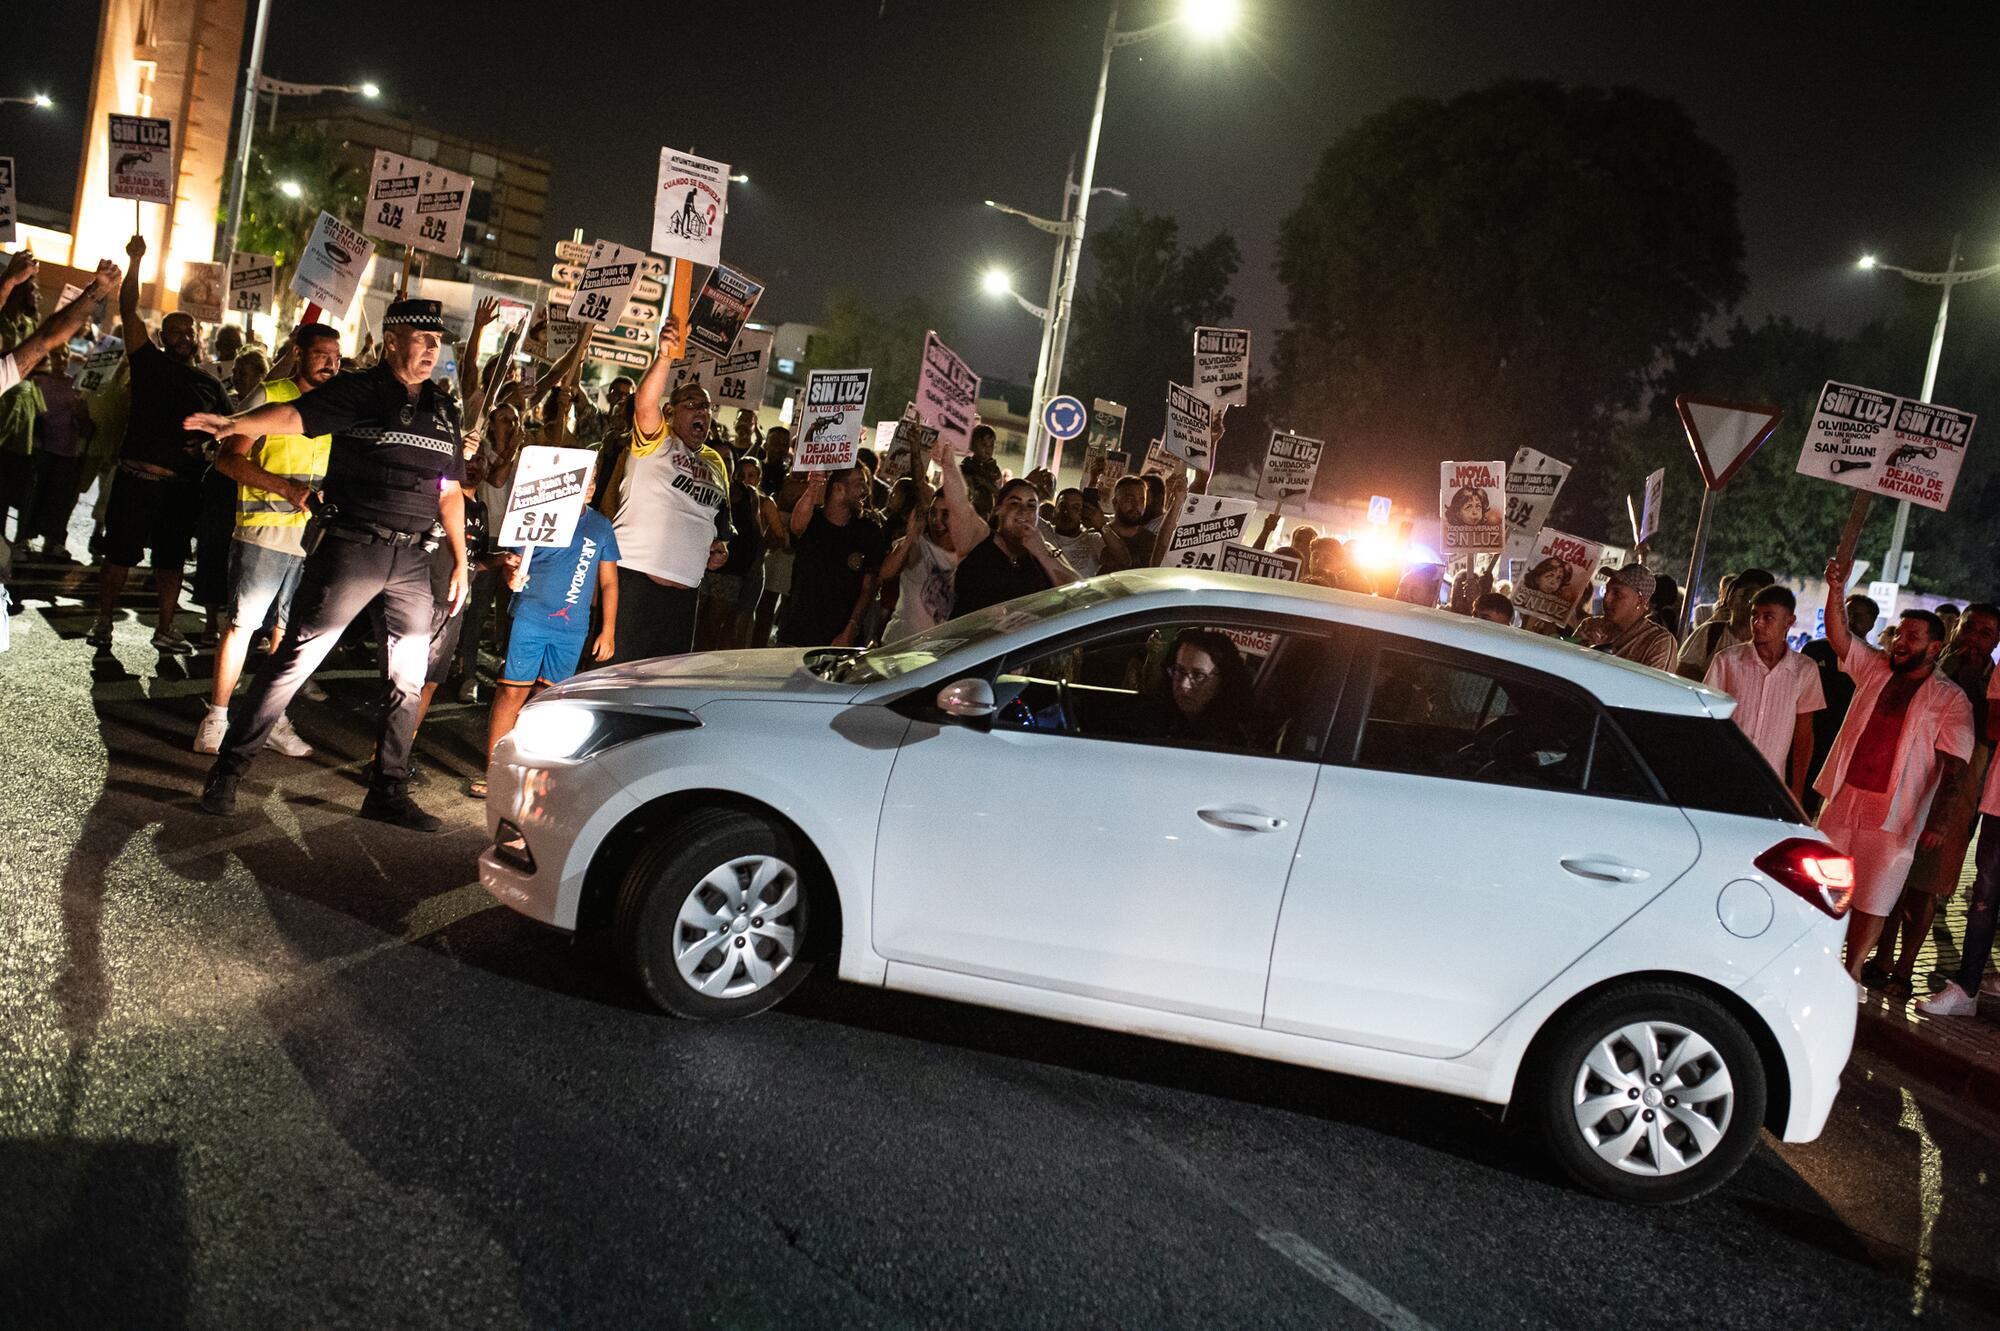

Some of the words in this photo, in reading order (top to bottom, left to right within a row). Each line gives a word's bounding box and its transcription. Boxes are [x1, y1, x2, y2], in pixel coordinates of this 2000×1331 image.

[112, 124, 137, 142] SIN
[140, 126, 168, 145] LUZ
[671, 155, 719, 174] AYUNTAMIENTO
[119, 176, 150, 186] DEJAD
[152, 178, 165, 188] DE
[664, 178, 688, 190] CUANDO
[690, 178, 697, 186] SE
[698, 181, 721, 205] EMPIEZA
[377, 212, 403, 229] LUZ
[706, 203, 717, 236] ?
[324, 216, 355, 239] ¡BASTA
[356, 235, 368, 249] DE
[419, 226, 447, 243] LUZ
[323, 226, 365, 256] SILENCIO!
[585, 269, 599, 280] San
[600, 266, 618, 277] Juan
[619, 265, 629, 275] de
[582, 275, 630, 290] Aznalfarache
[639, 284, 658, 295] Juan
[240, 291, 260, 301] SN
[315, 290, 327, 301] YA!
[237, 300, 261, 311] LUZ
[578, 303, 609, 321] LUZ
[550, 308, 568, 320] SIN
[1200, 336, 1220, 352] SIN
[1221, 338, 1246, 354] LUZ
[594, 347, 615, 360] Virgen
[615, 351, 626, 362] del
[1199, 355, 1241, 366] OLVIDADOS
[928, 345, 950, 376] SIN
[950, 362, 975, 398] LUZ
[1200, 375, 1217, 383] SAN
[1220, 372, 1243, 382] JUAN!
[723, 376, 746, 389] SN
[720, 386, 746, 400] LUZ
[811, 383, 837, 402] SIN
[837, 381, 866, 402] LUZ
[1839, 388, 1860, 397] SANTA
[1861, 393, 1883, 403] ISABEL
[810, 405, 818, 413] LA
[819, 405, 832, 413] LUZ
[1172, 391, 1188, 411] SIN
[1190, 403, 1209, 422] LUZ
[1823, 391, 1856, 416] SIN
[1855, 399, 1890, 424] LUZ
[1914, 405, 1935, 416] SANTA
[1936, 411, 1959, 422] ISABEL
[1171, 412, 1206, 431] OLVIDADOS
[1817, 420, 1880, 434] OLVIDADOS
[1899, 409, 1932, 434] SIN
[1930, 417, 1968, 444] LUZ
[814, 434, 847, 442] endesa
[1173, 430, 1187, 441] SAN
[1846, 432, 1871, 440] RINCÓN
[1907, 434, 1922, 443] LUZ
[1923, 437, 1934, 445] ES
[806, 443, 837, 453] DEJAD
[838, 442, 851, 451] DE
[1273, 440, 1294, 457] SIN
[1293, 444, 1318, 462] LUZ
[1814, 442, 1839, 453] SAN
[1840, 445, 1877, 457] JUAN!
[800, 453, 852, 464] MATARNOS!
[1269, 460, 1311, 469] OLVIDADOS
[1456, 465, 1490, 478] MOYA
[1897, 460, 1940, 477] endesa
[514, 485, 535, 497] San
[536, 478, 562, 495] Juan
[563, 473, 576, 485] de
[1268, 476, 1284, 484] SAN
[1286, 477, 1309, 485] JUAN!
[1450, 479, 1460, 488] DA
[1461, 479, 1472, 488] LA
[1474, 475, 1500, 489] CARA!
[1508, 475, 1523, 483] San
[1525, 475, 1541, 484] Juan
[1543, 476, 1553, 484] de
[1886, 468, 1925, 485] DEJAD
[1927, 478, 1943, 491] DE
[1878, 477, 1944, 503] MATARNOS!
[522, 512, 558, 527] SN
[1177, 526, 1195, 537] San
[1198, 522, 1221, 533] Juan
[1222, 517, 1235, 528] de
[1508, 510, 1530, 528] UZ
[515, 527, 557, 542] LUZ
[1174, 527, 1239, 549] Aznalfarache
[1447, 532, 1469, 546] SIN
[1473, 532, 1500, 546] LUZ
[1551, 537, 1586, 558] MOYA
[1224, 555, 1255, 576] SIN
[1238, 551, 1260, 562] SANTA
[1261, 555, 1284, 567] ISABEL
[1541, 546, 1553, 556] DA
[1554, 551, 1564, 559] LA
[1565, 554, 1593, 571] CARA!
[565, 556, 591, 604] JORDAN
[1514, 594, 1538, 610] SIN
[1540, 599, 1568, 618] LUZ
[1227, 632, 1272, 652] TARNOS
